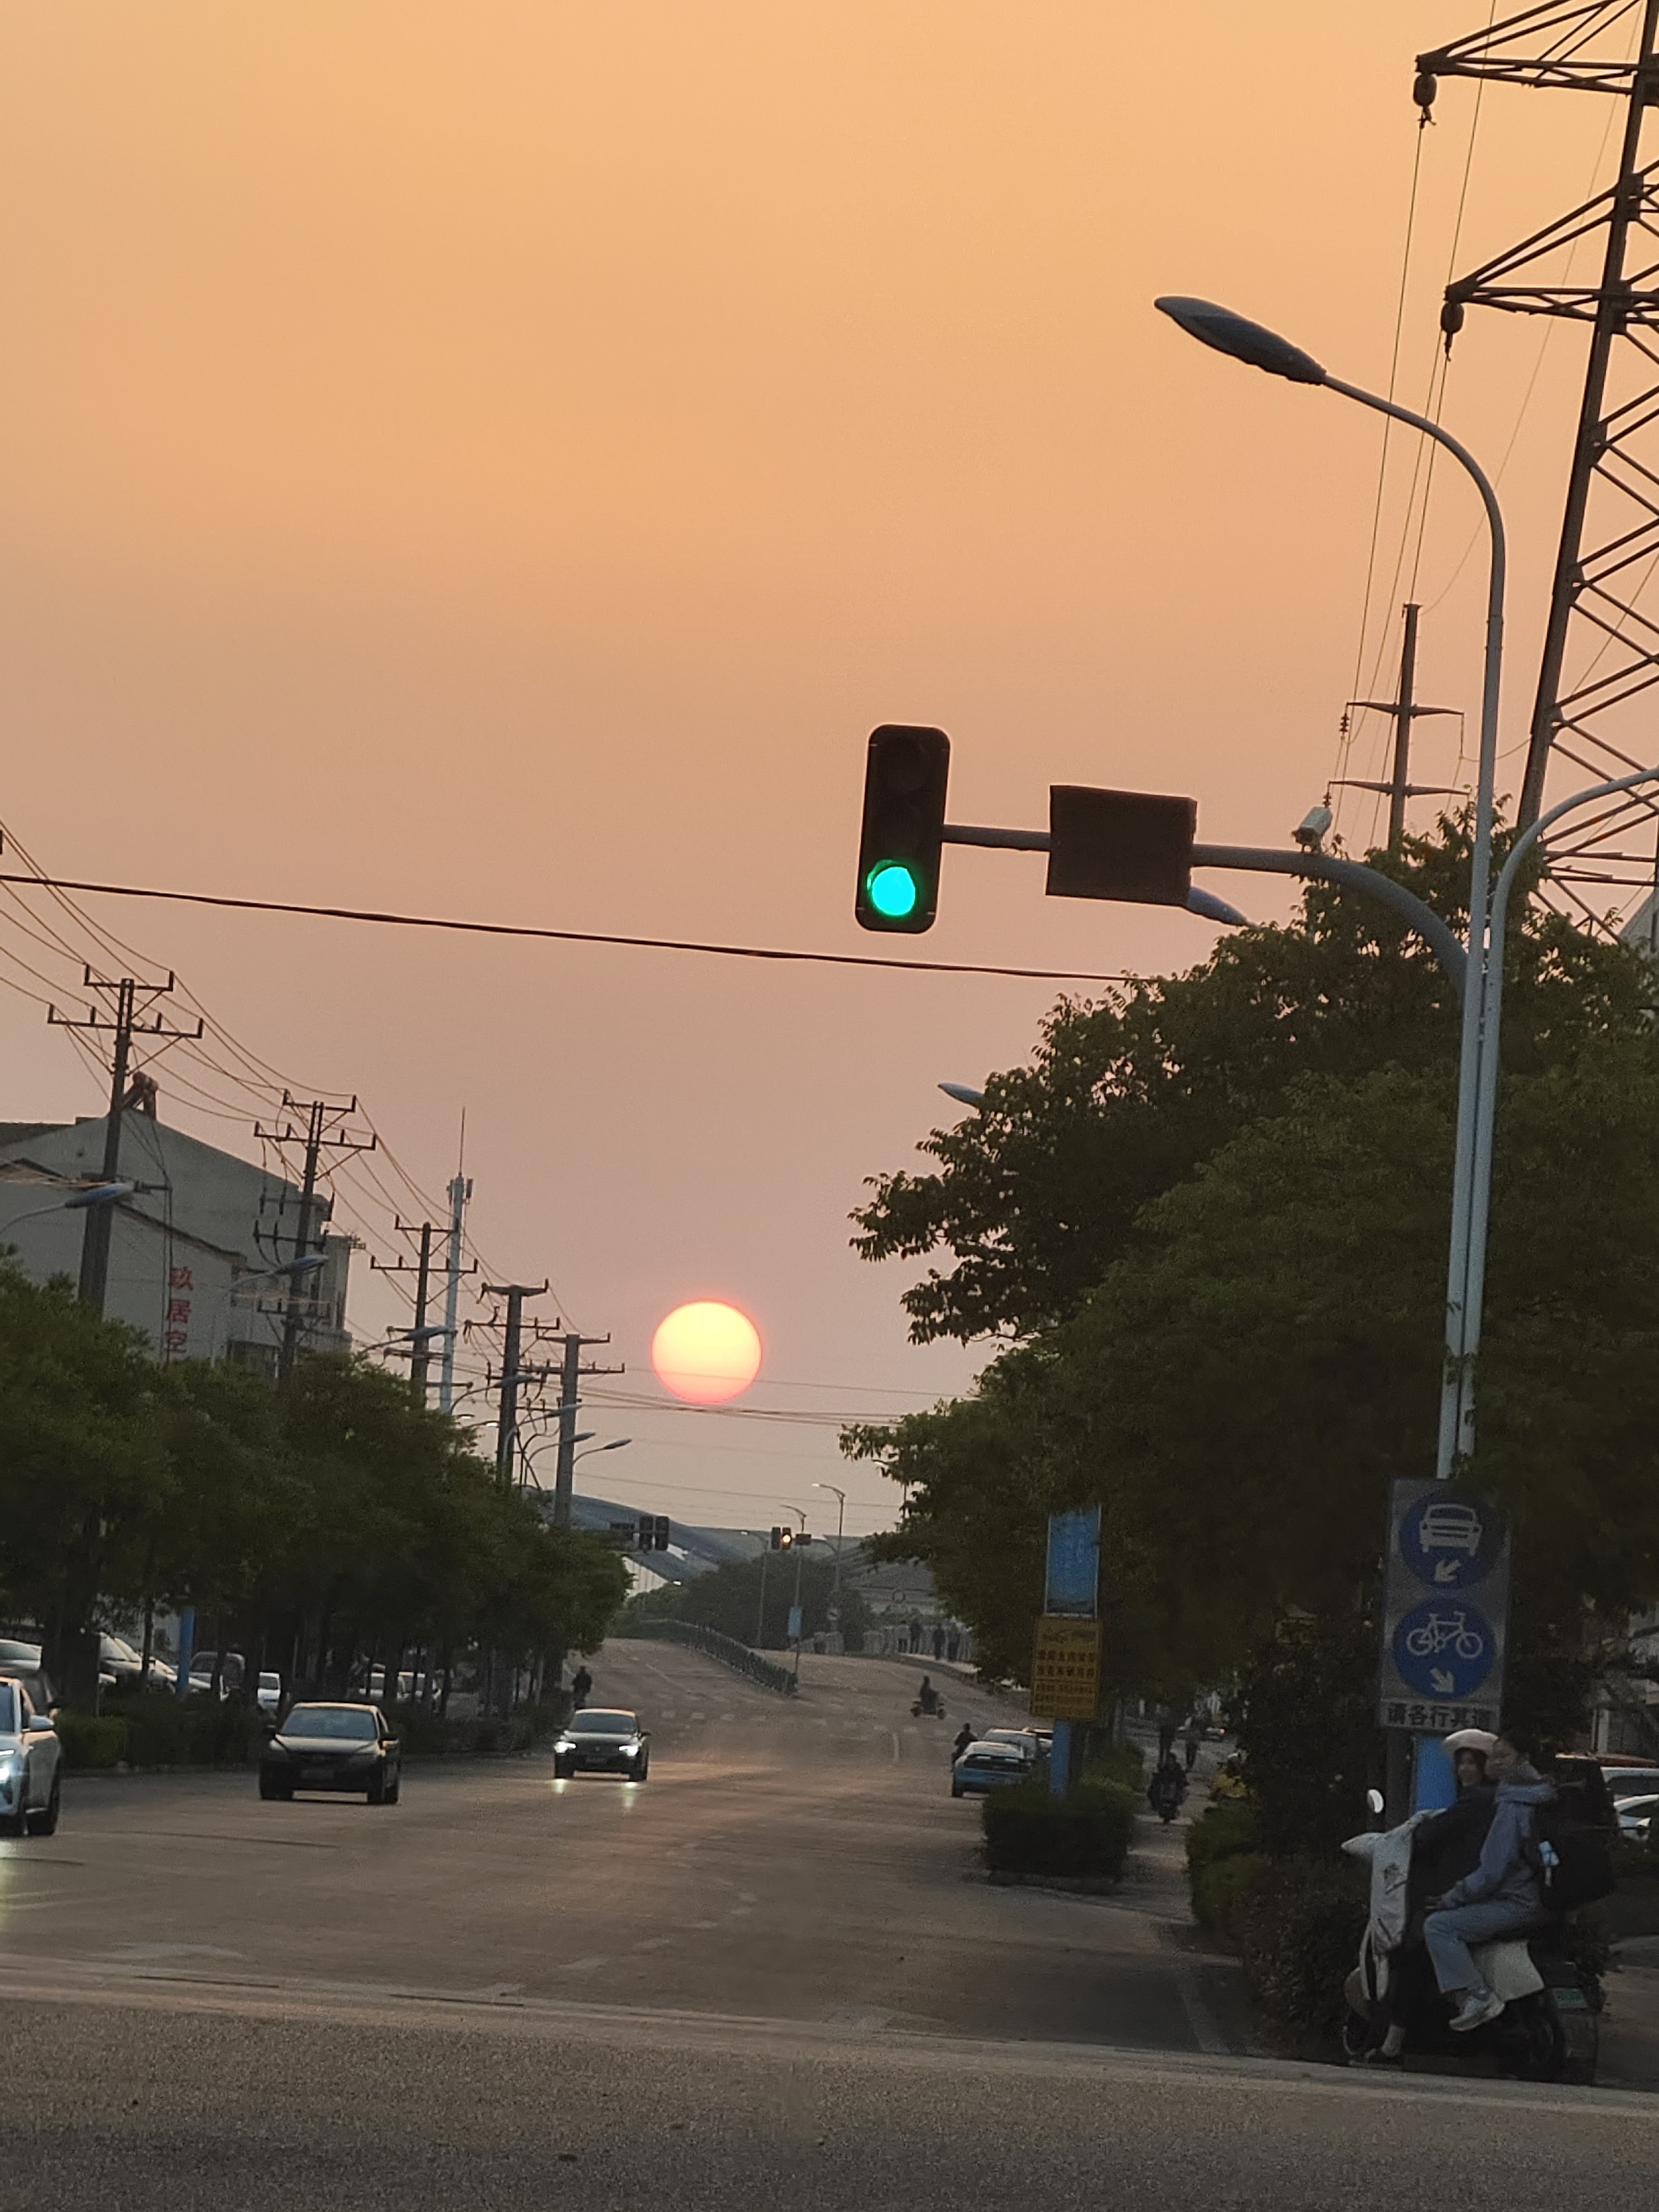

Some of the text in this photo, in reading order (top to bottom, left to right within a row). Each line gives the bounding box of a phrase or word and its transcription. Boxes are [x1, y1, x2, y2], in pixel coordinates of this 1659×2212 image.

[1387, 1702, 1493, 1729] 请各行其道
